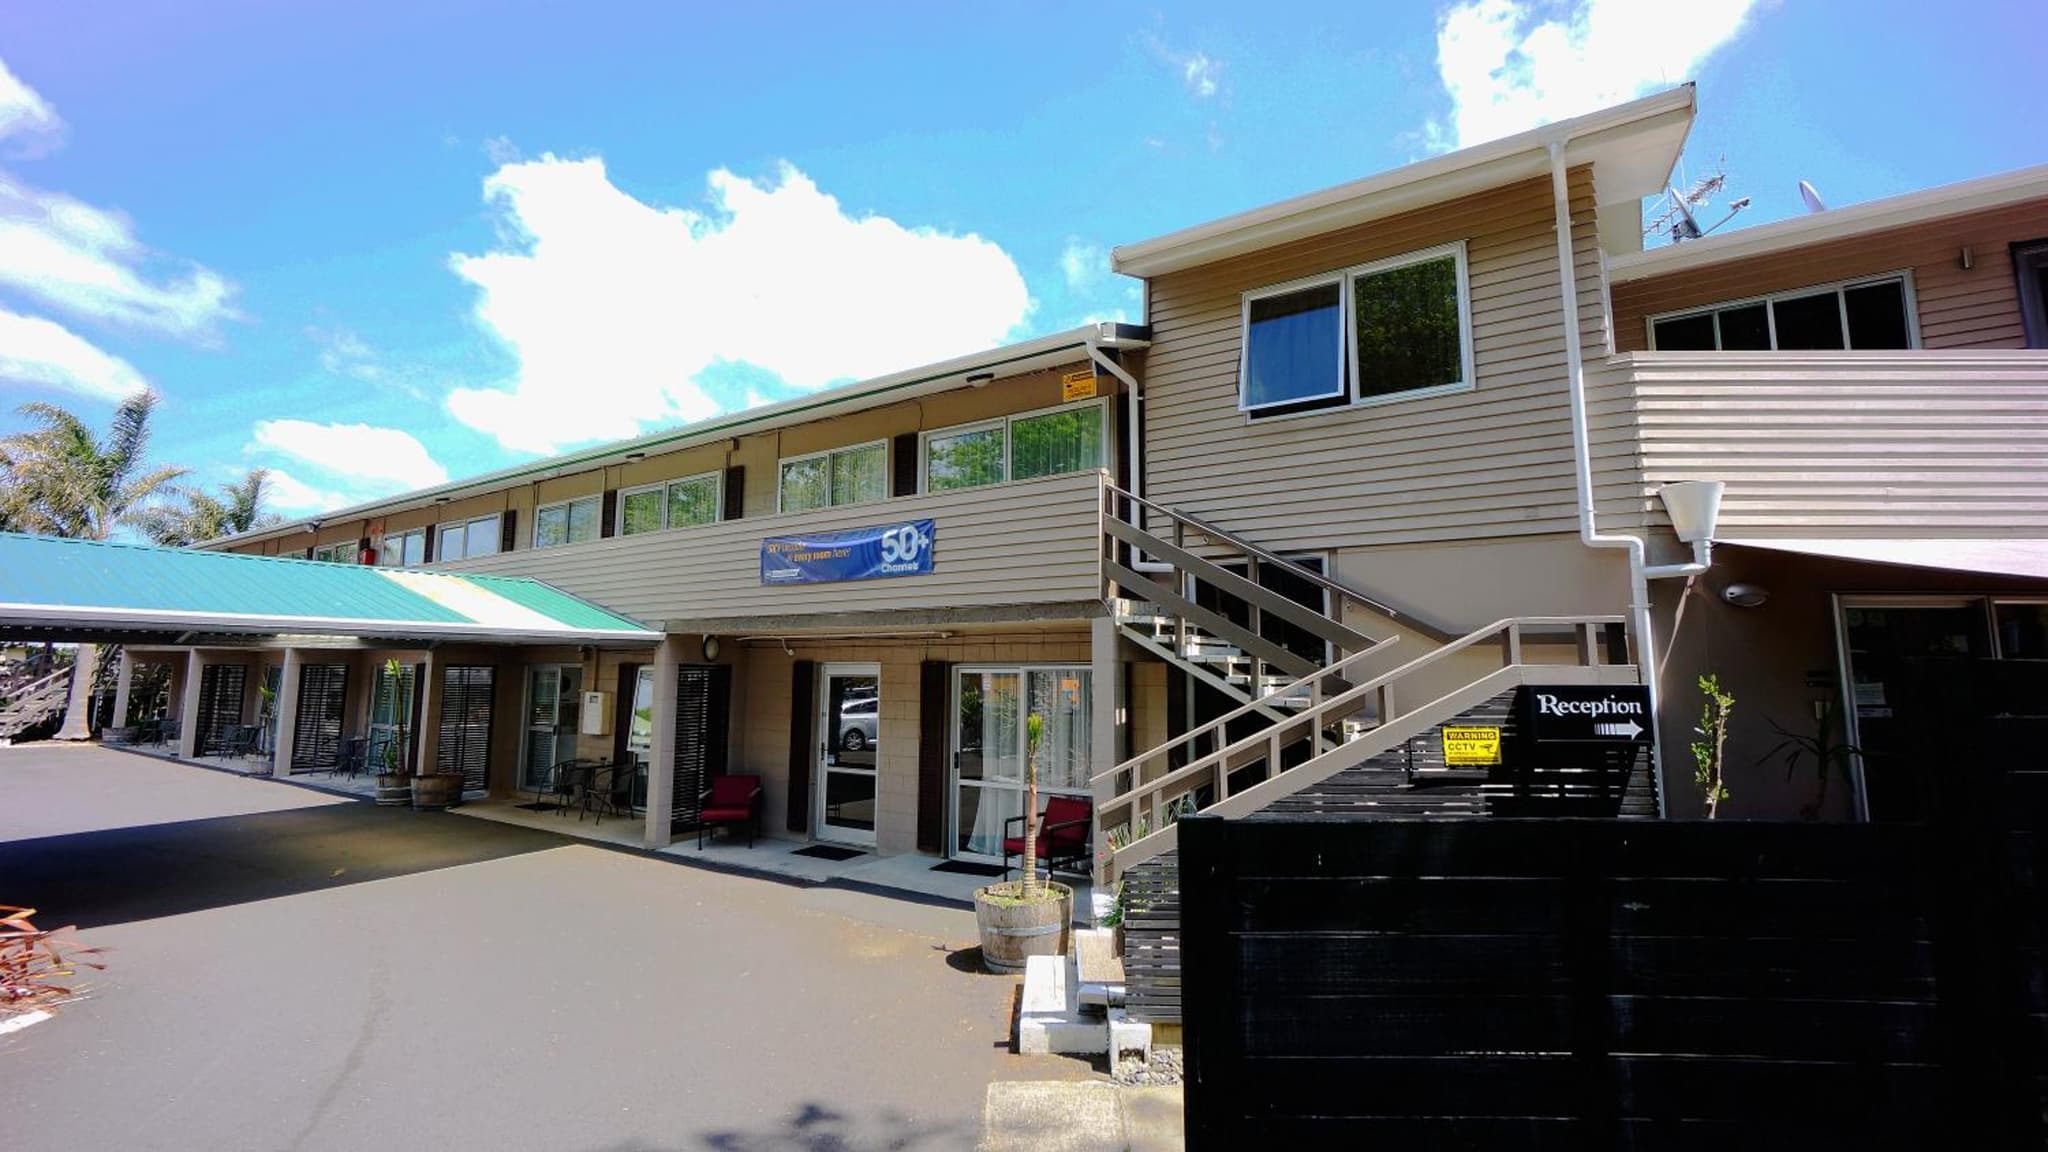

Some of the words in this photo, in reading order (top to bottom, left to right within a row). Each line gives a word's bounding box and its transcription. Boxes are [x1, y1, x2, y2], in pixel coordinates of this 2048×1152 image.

[881, 524, 929, 562] 50+
[881, 561, 919, 573] Channels
[1536, 694, 1643, 718] Reception
[1448, 731, 1496, 740] WARNING
[1448, 743, 1476, 752] CCTV
